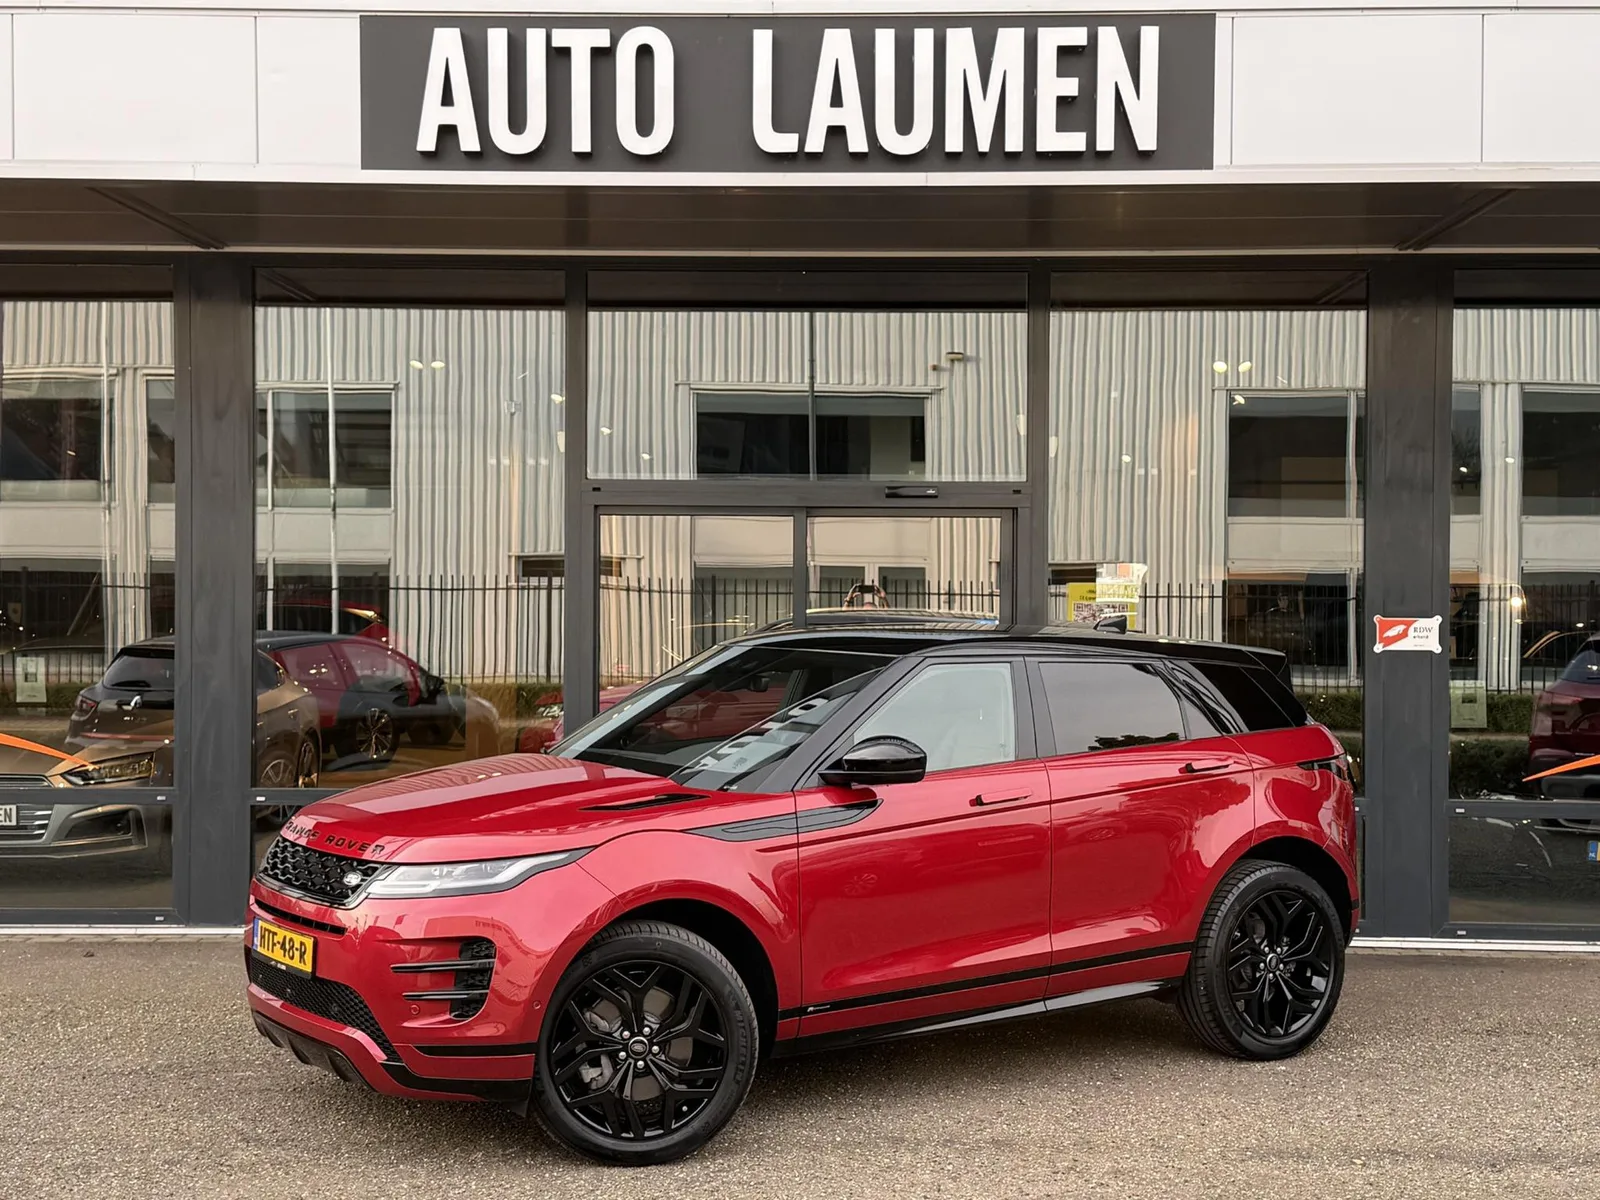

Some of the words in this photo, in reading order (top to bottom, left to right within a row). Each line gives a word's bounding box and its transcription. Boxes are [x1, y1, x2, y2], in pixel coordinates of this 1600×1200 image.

[416, 26, 674, 155] AUTO
[753, 26, 1159, 155] LAUMEN
[1413, 626, 1433, 634] RDW
[285, 821, 320, 838] RANGE
[324, 834, 385, 854] ROVER
[260, 925, 307, 966] HTF-48-R
